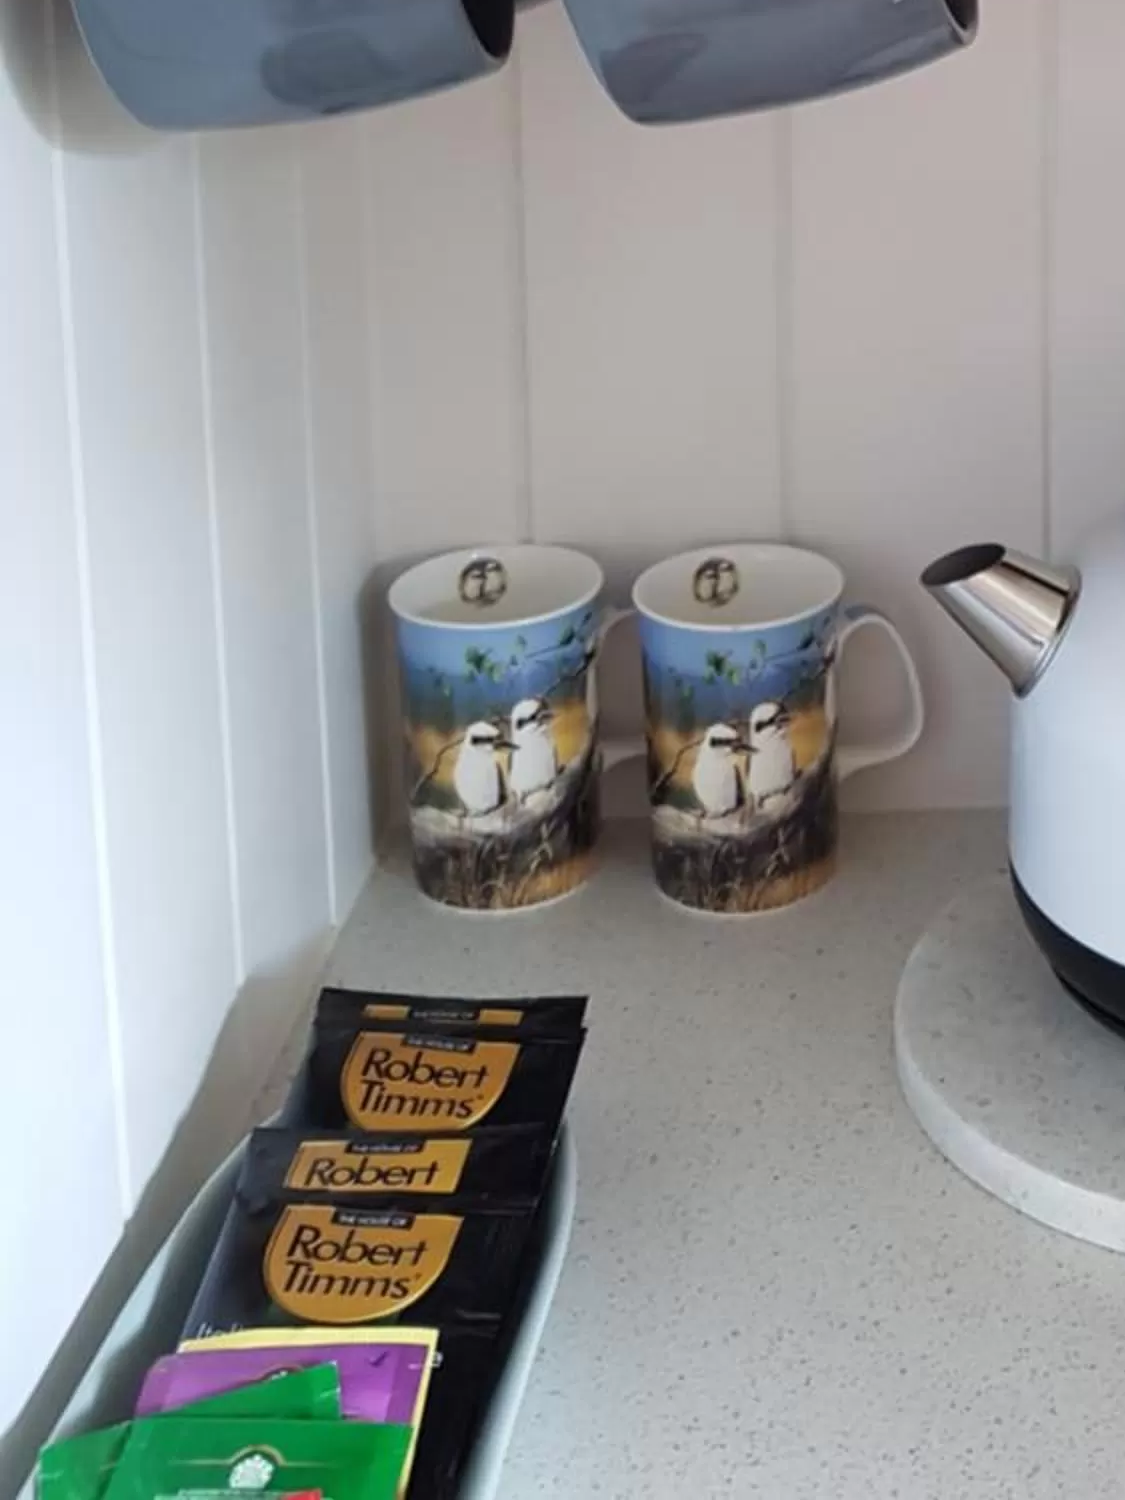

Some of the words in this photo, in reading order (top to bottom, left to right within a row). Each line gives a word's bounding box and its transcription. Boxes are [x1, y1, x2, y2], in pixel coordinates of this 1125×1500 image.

[360, 1047, 489, 1089] Robert
[359, 1079, 475, 1120] Timms
[303, 1156, 439, 1187] Robert
[286, 1223, 428, 1268] Robert
[282, 1259, 411, 1300] Timms
